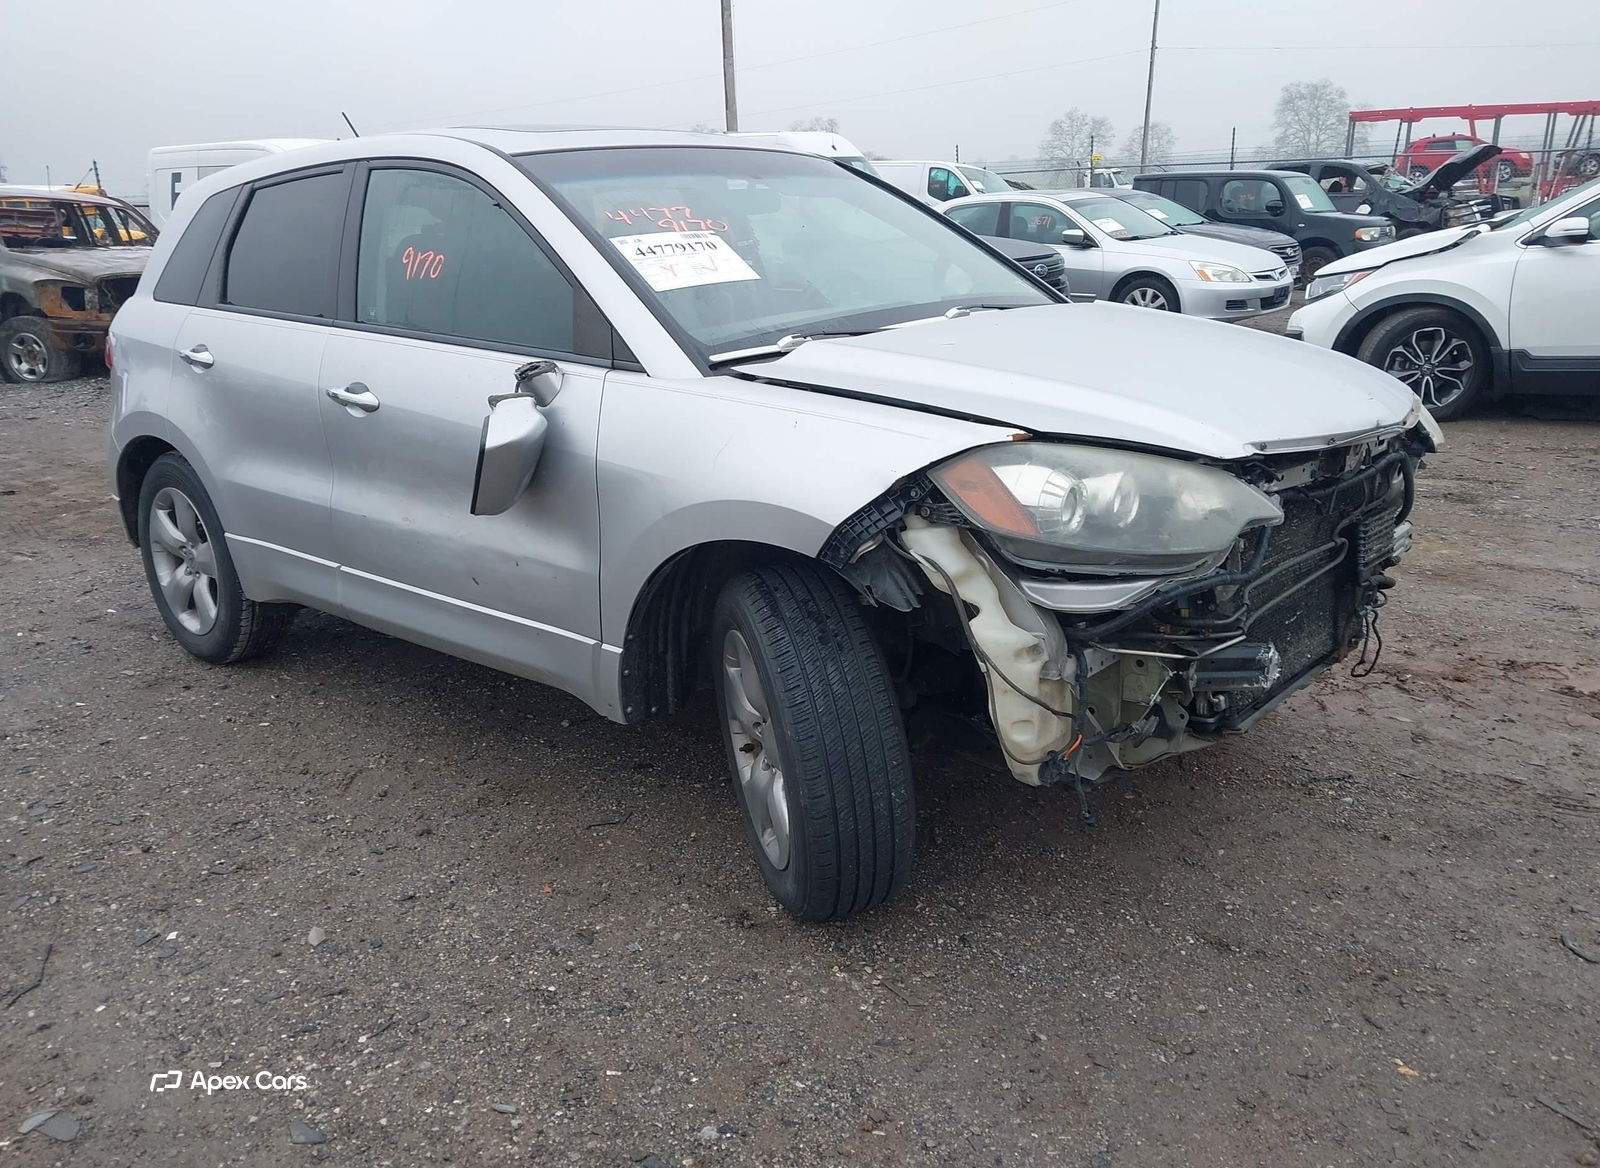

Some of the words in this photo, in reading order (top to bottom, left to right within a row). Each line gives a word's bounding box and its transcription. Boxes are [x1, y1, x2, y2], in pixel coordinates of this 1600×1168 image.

[657, 217, 729, 233] 9170
[635, 241, 718, 257] 44779170
[402, 246, 445, 280] 9170
